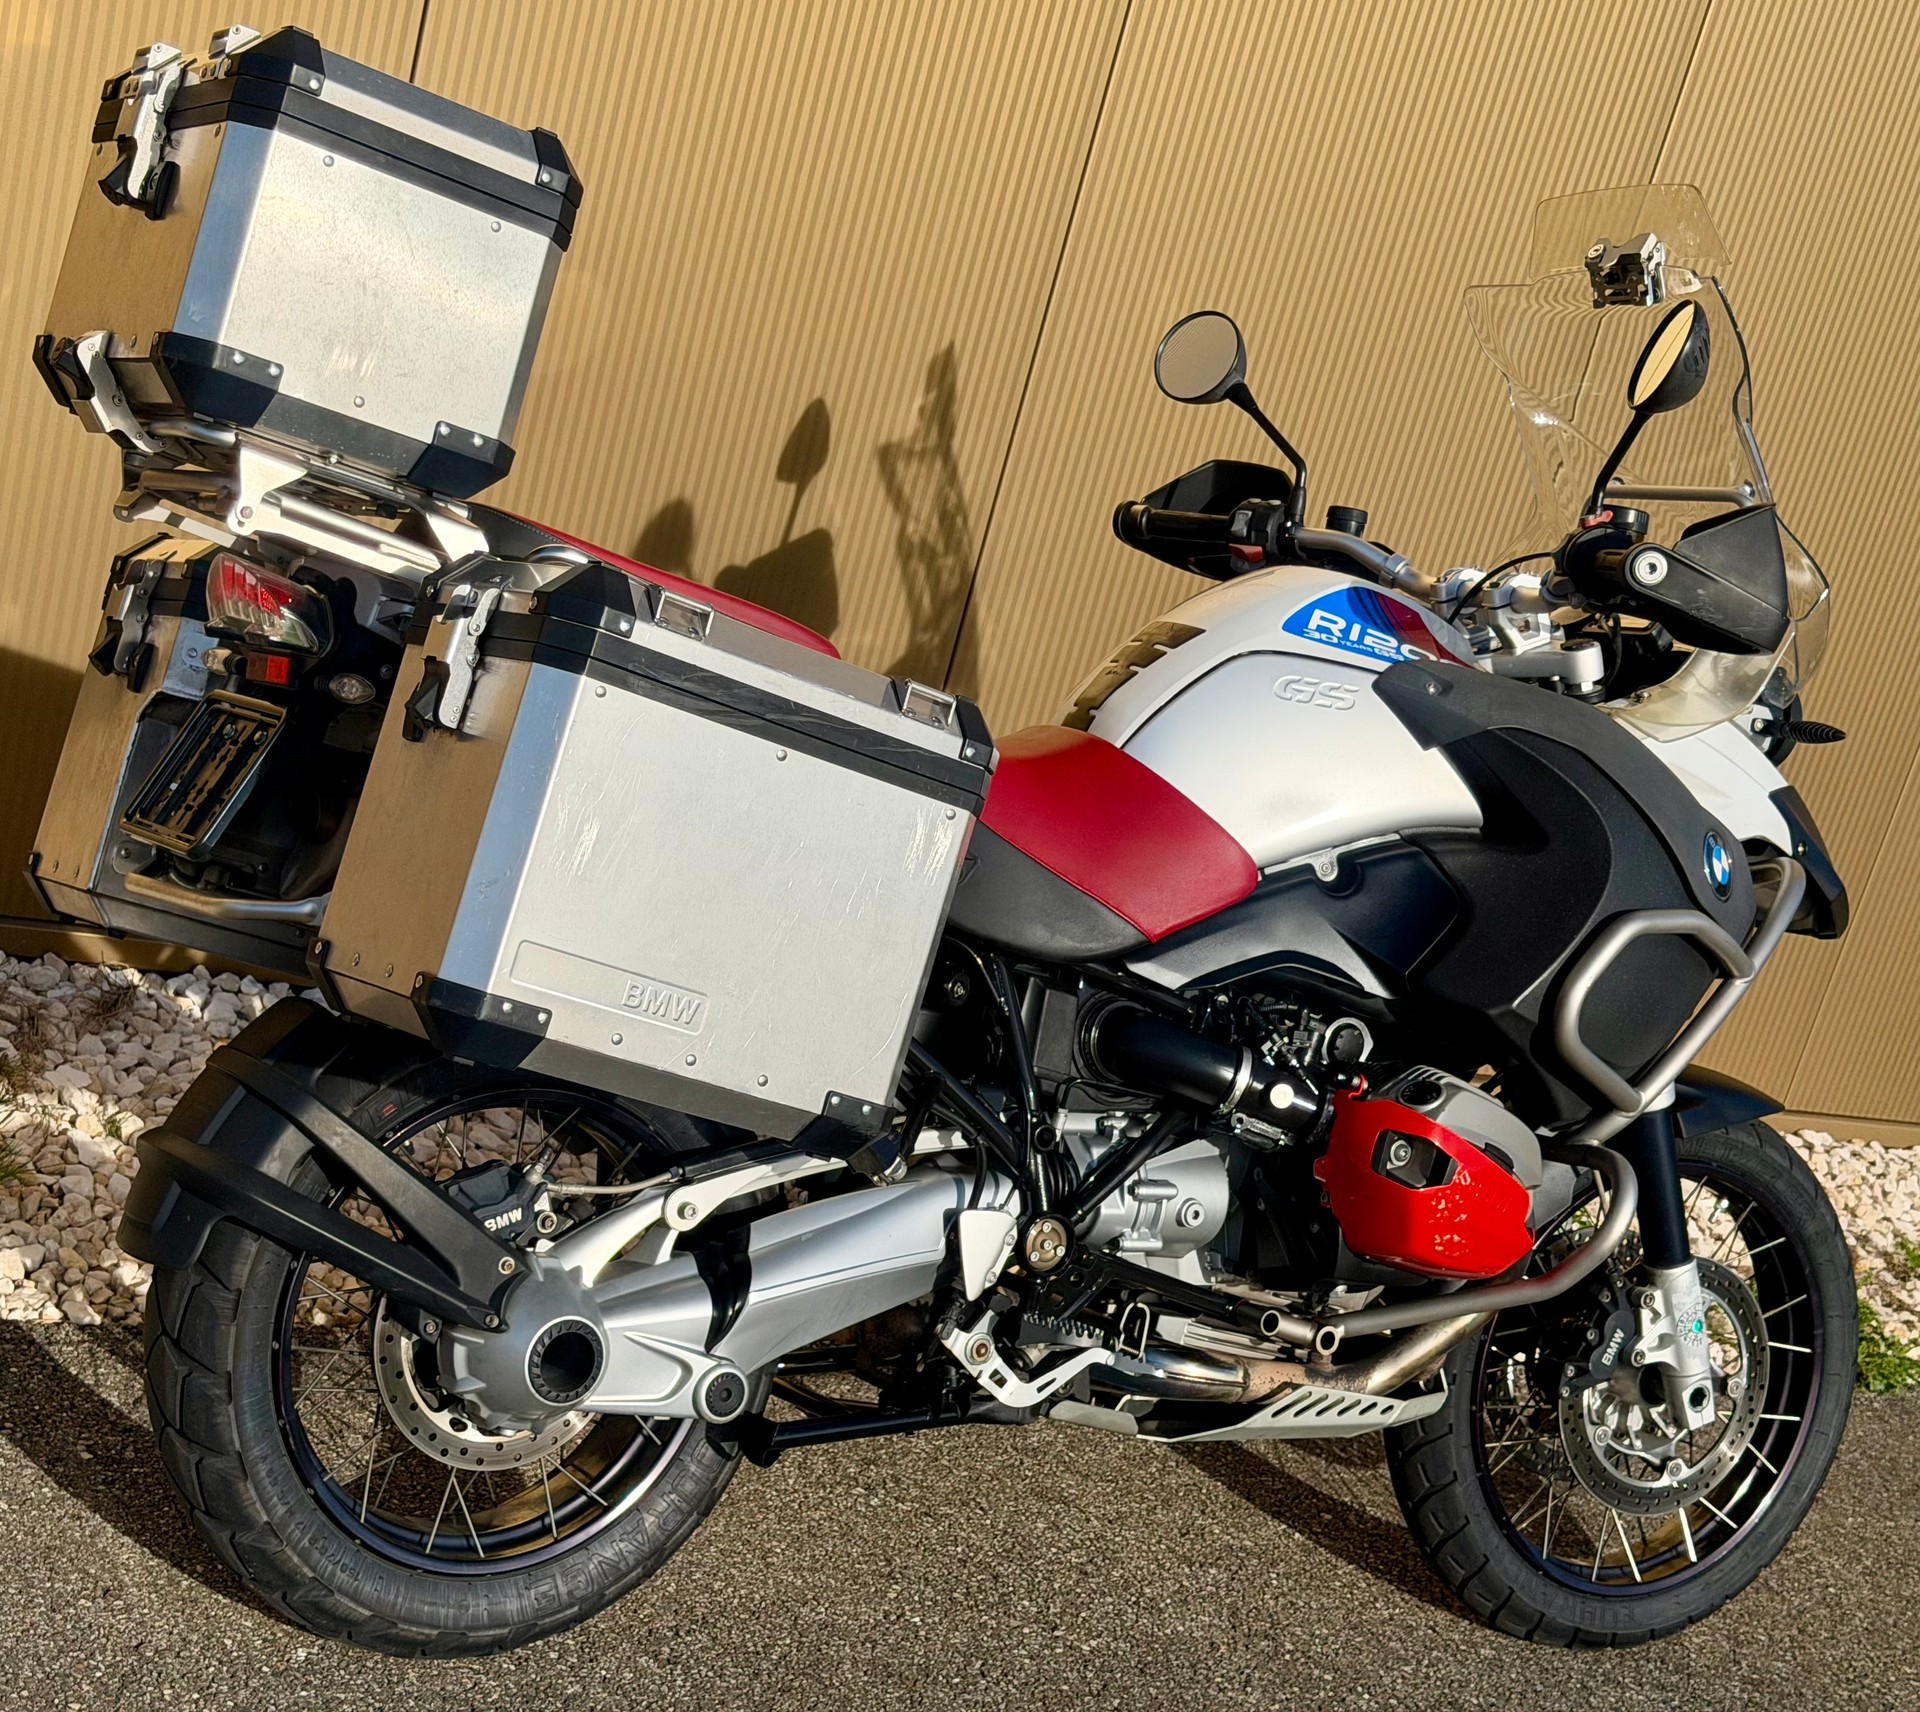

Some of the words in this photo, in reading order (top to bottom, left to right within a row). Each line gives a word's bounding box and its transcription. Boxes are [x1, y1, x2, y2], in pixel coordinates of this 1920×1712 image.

[1303, 628, 1338, 644] 30
[1339, 639, 1374, 653] YEARS
[1374, 647, 1404, 662] GS
[1307, 608, 1438, 661] R120
[1272, 674, 1360, 711] GS
[620, 978, 701, 1025] BMW
[1601, 1327, 1625, 1366] BMW
[529, 1436, 725, 1618] OURANCE
